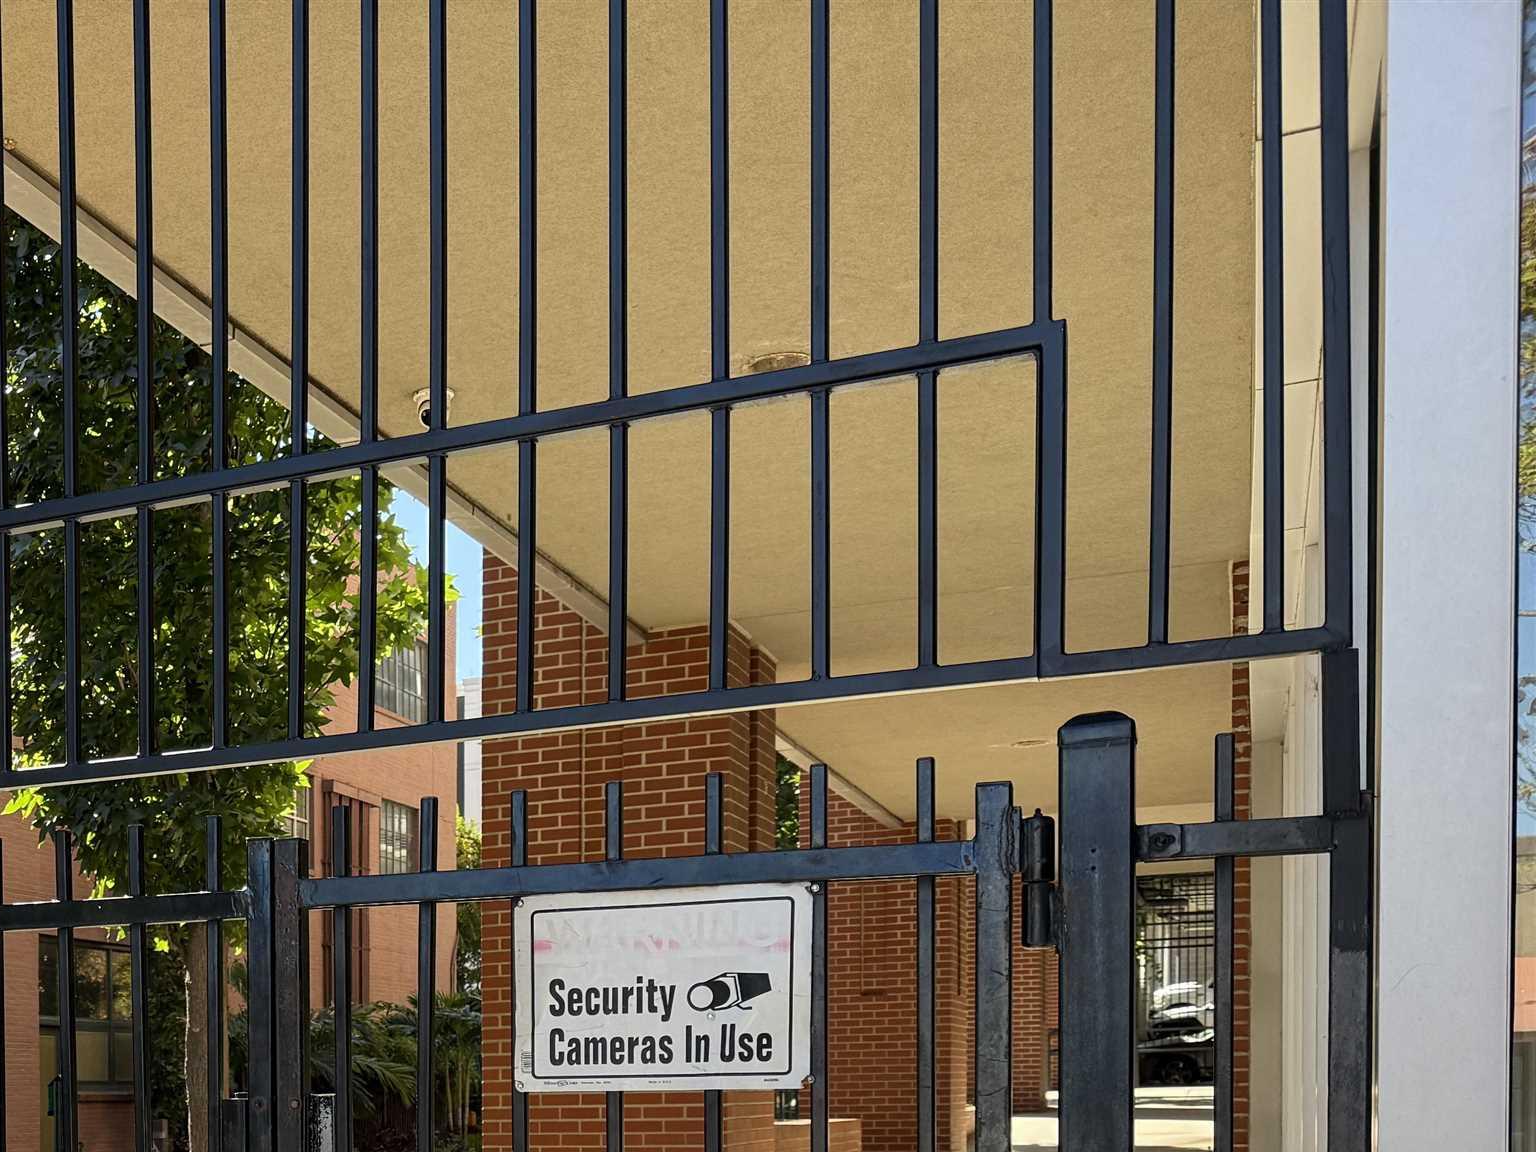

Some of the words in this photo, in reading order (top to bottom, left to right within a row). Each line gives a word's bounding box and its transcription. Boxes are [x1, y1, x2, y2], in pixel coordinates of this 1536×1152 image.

[549, 975, 677, 1023] Security
[549, 1027, 674, 1066] Cameras
[685, 1024, 710, 1064] In
[719, 1023, 773, 1063] Use
